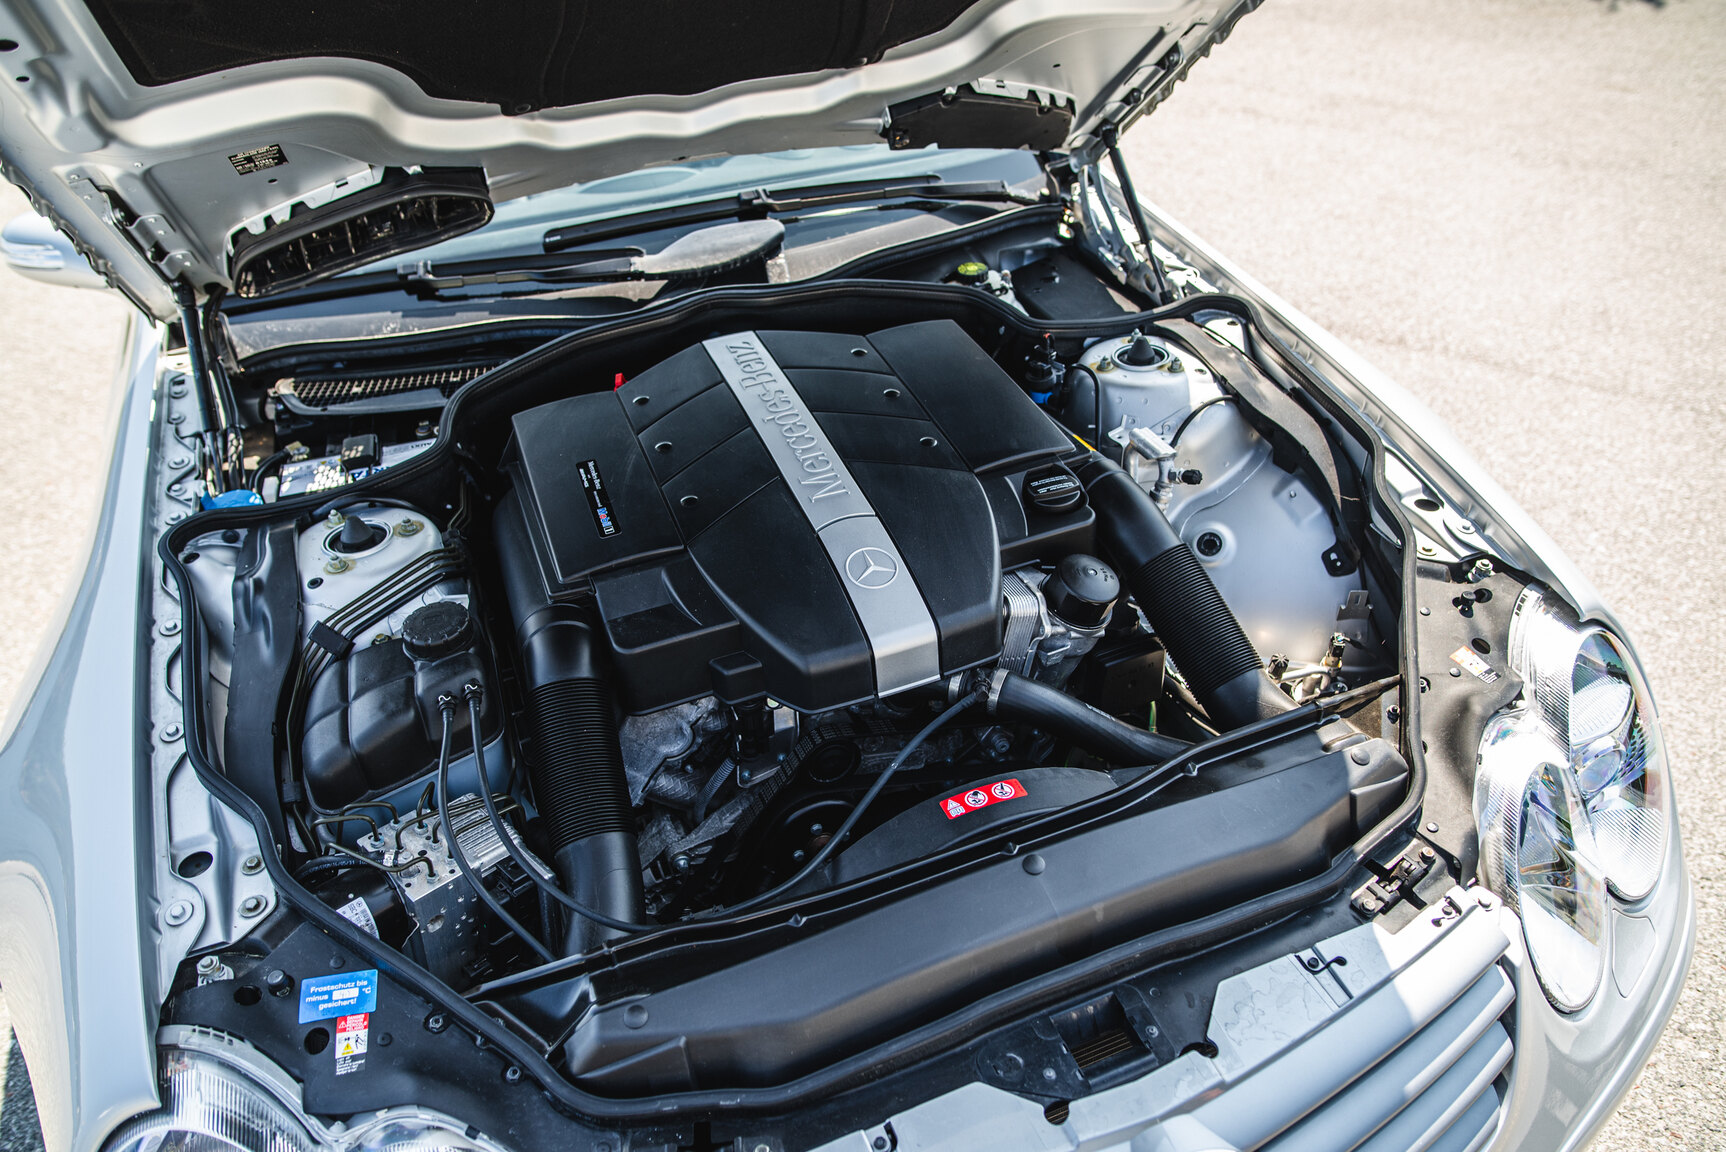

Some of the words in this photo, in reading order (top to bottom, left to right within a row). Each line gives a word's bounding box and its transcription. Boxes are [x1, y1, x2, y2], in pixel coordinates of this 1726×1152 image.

[726, 341, 851, 503] Mercedes-Benz
[597, 507, 612, 527] Mobil
[310, 982, 355, 993] Frostschutz
[305, 994, 329, 1003] minus
[318, 998, 357, 1011] gesichert!
